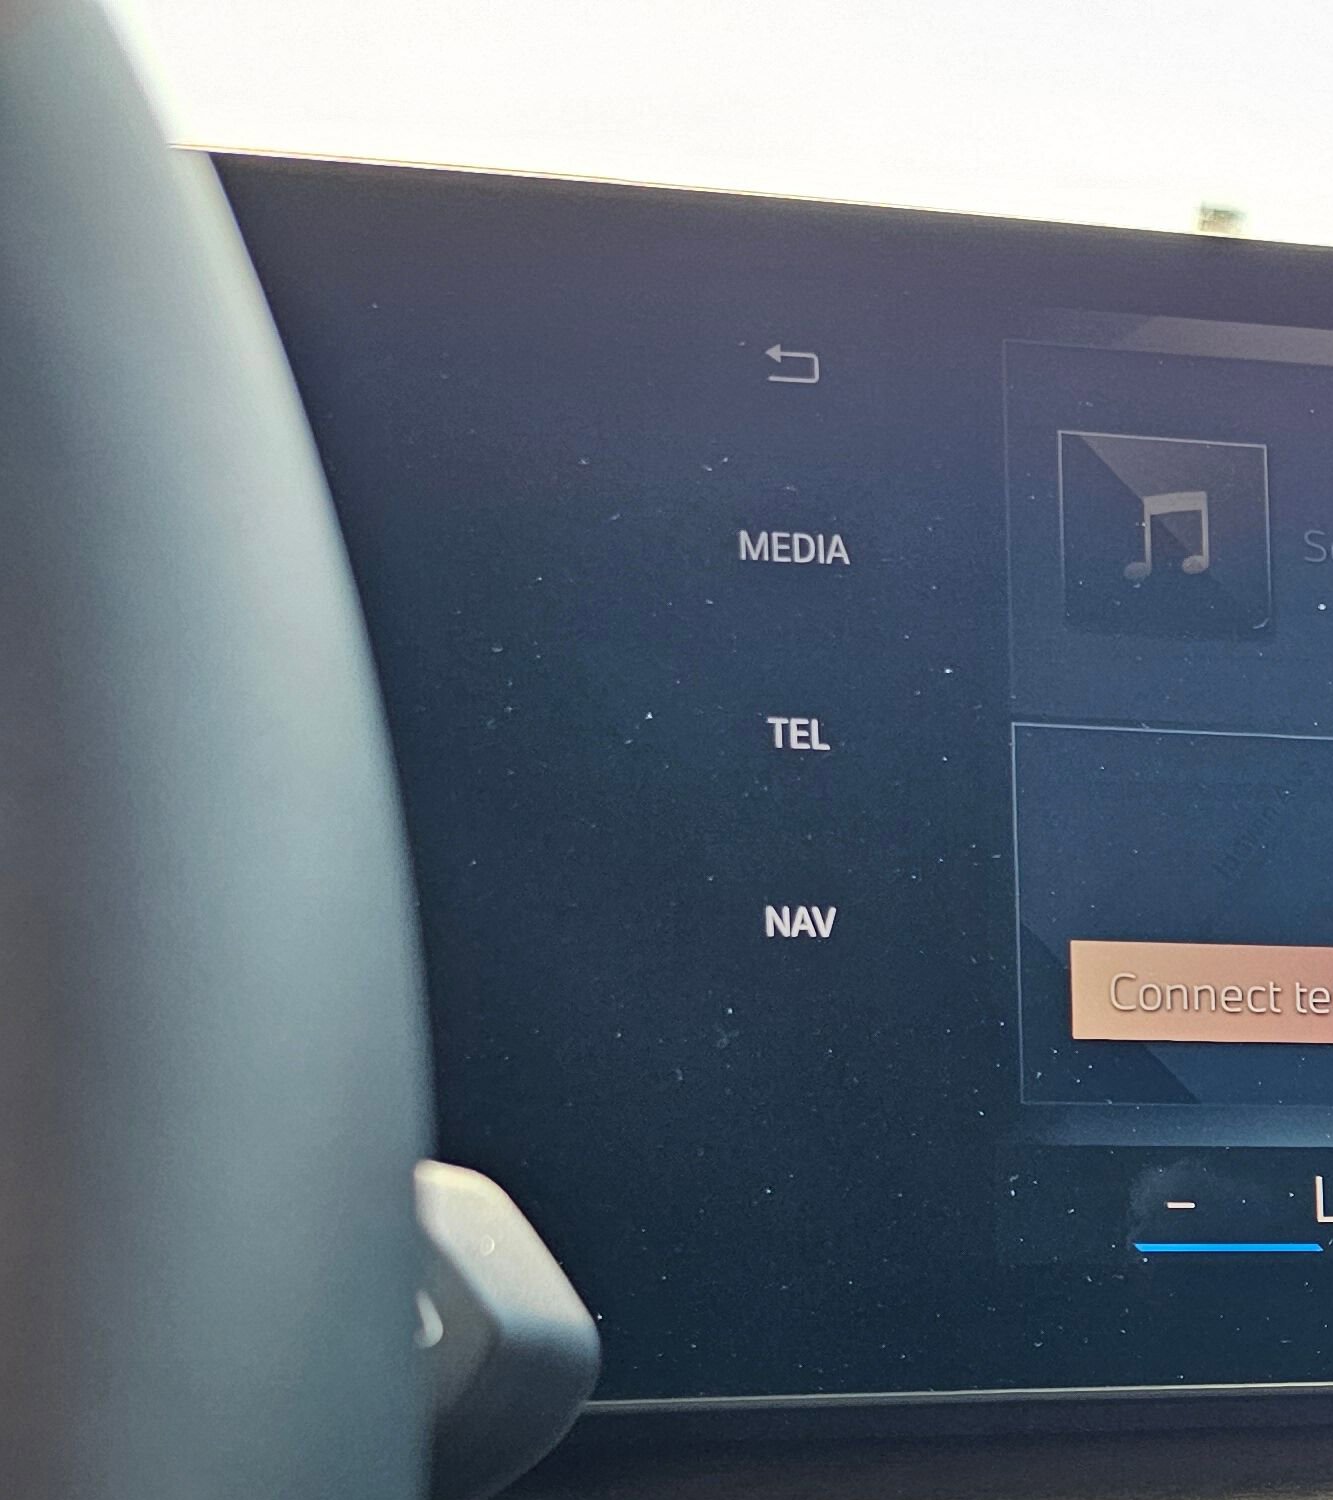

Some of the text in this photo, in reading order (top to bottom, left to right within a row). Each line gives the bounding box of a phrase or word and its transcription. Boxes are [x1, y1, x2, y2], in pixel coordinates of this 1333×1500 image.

[739, 529, 850, 565] MEDIA
[767, 717, 830, 751] TEL
[765, 905, 837, 938] NAV
[1109, 972, 1282, 1014] Connect
